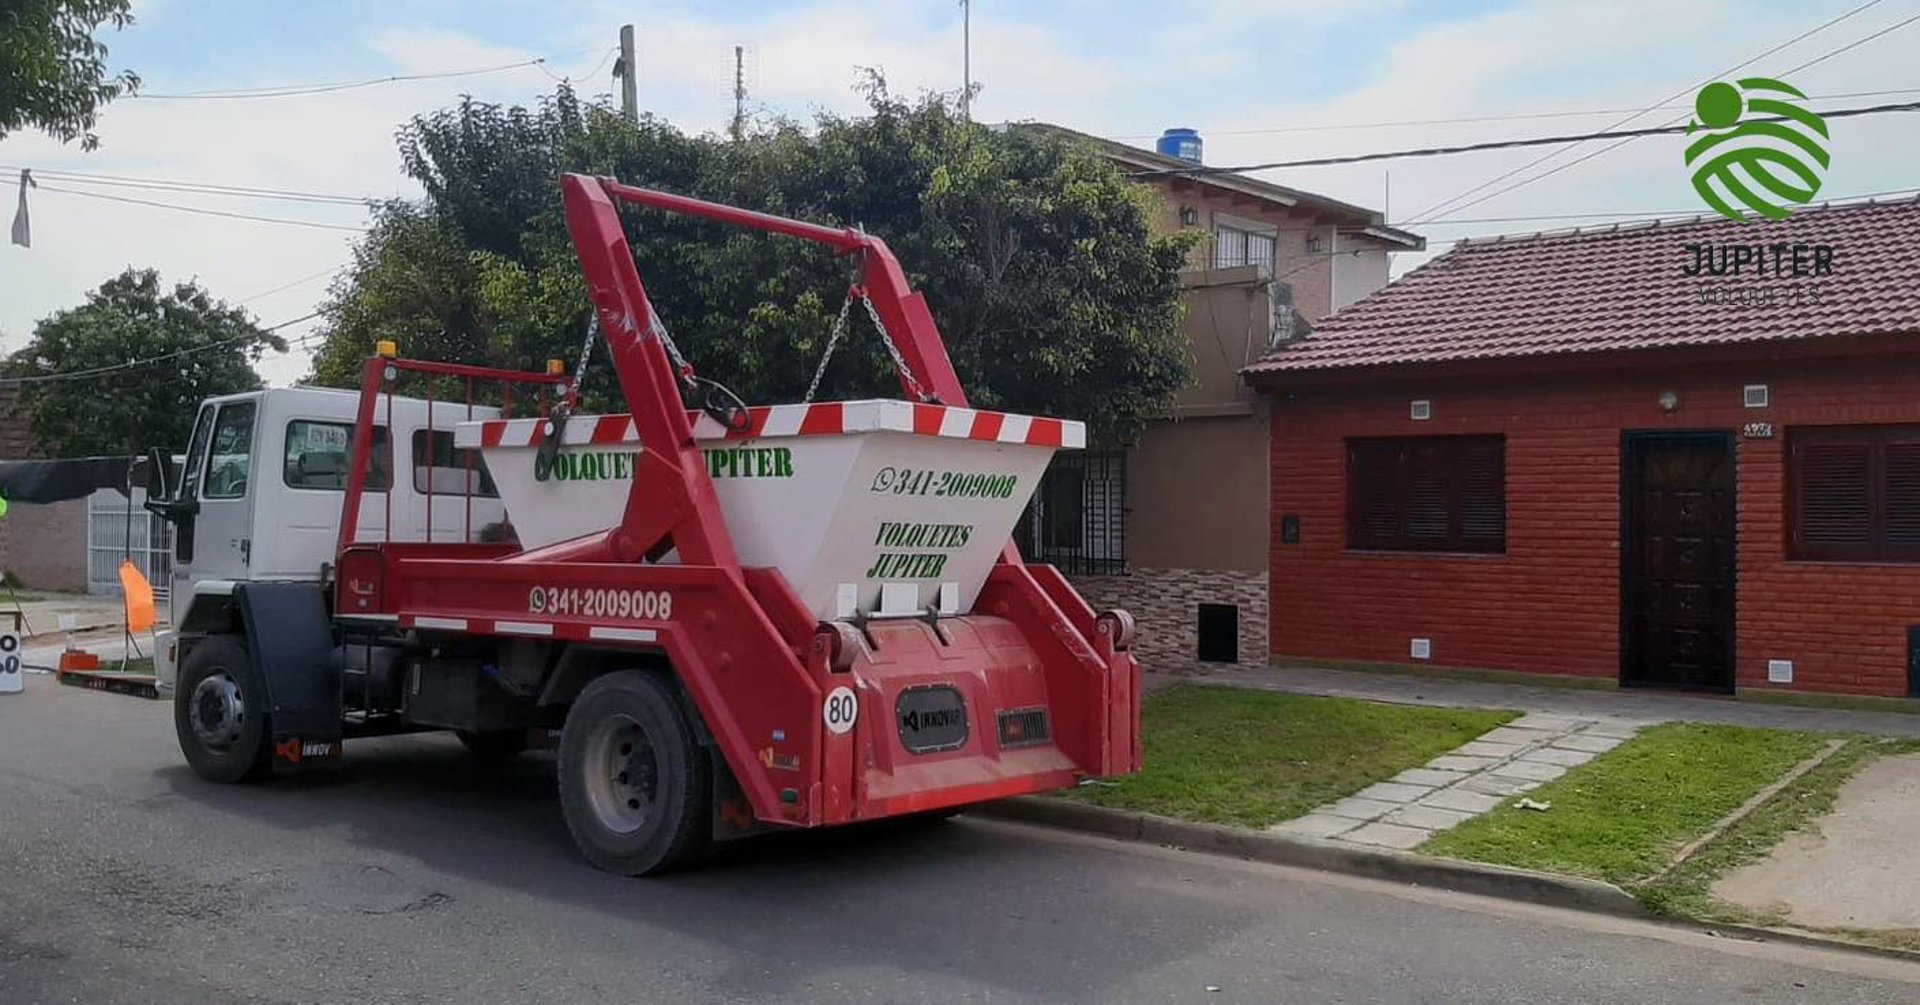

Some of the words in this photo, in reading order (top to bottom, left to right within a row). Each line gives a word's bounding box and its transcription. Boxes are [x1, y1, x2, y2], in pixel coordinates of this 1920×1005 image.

[704, 447, 794, 478] PITER
[893, 468, 1017, 499] 341-2009008
[875, 522, 973, 548] VOLQUETES
[866, 553, 948, 578] JUPITER
[829, 694, 853, 724] 80
